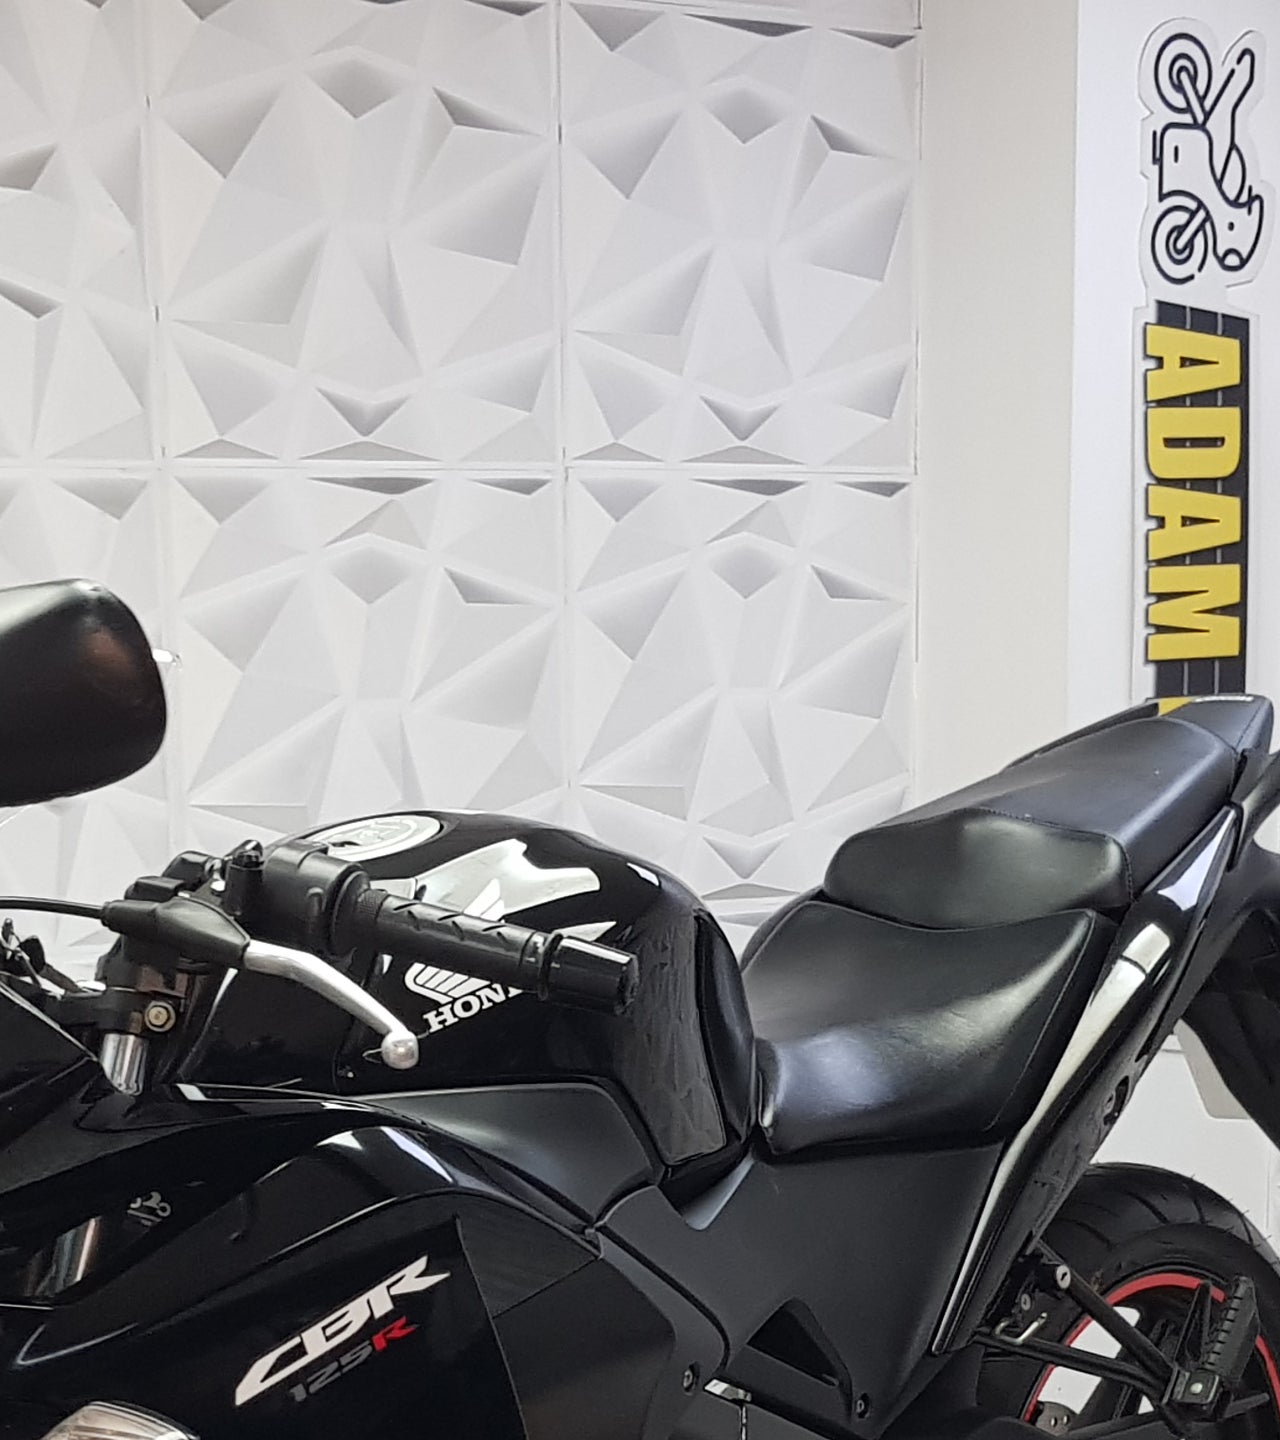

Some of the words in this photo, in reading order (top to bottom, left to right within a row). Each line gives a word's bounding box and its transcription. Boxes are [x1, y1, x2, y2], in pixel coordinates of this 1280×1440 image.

[1145, 322, 1242, 661] ADAM
[422, 983, 524, 1033] HON
[235, 1254, 451, 1406] CBR
[288, 1316, 419, 1403] 125R
